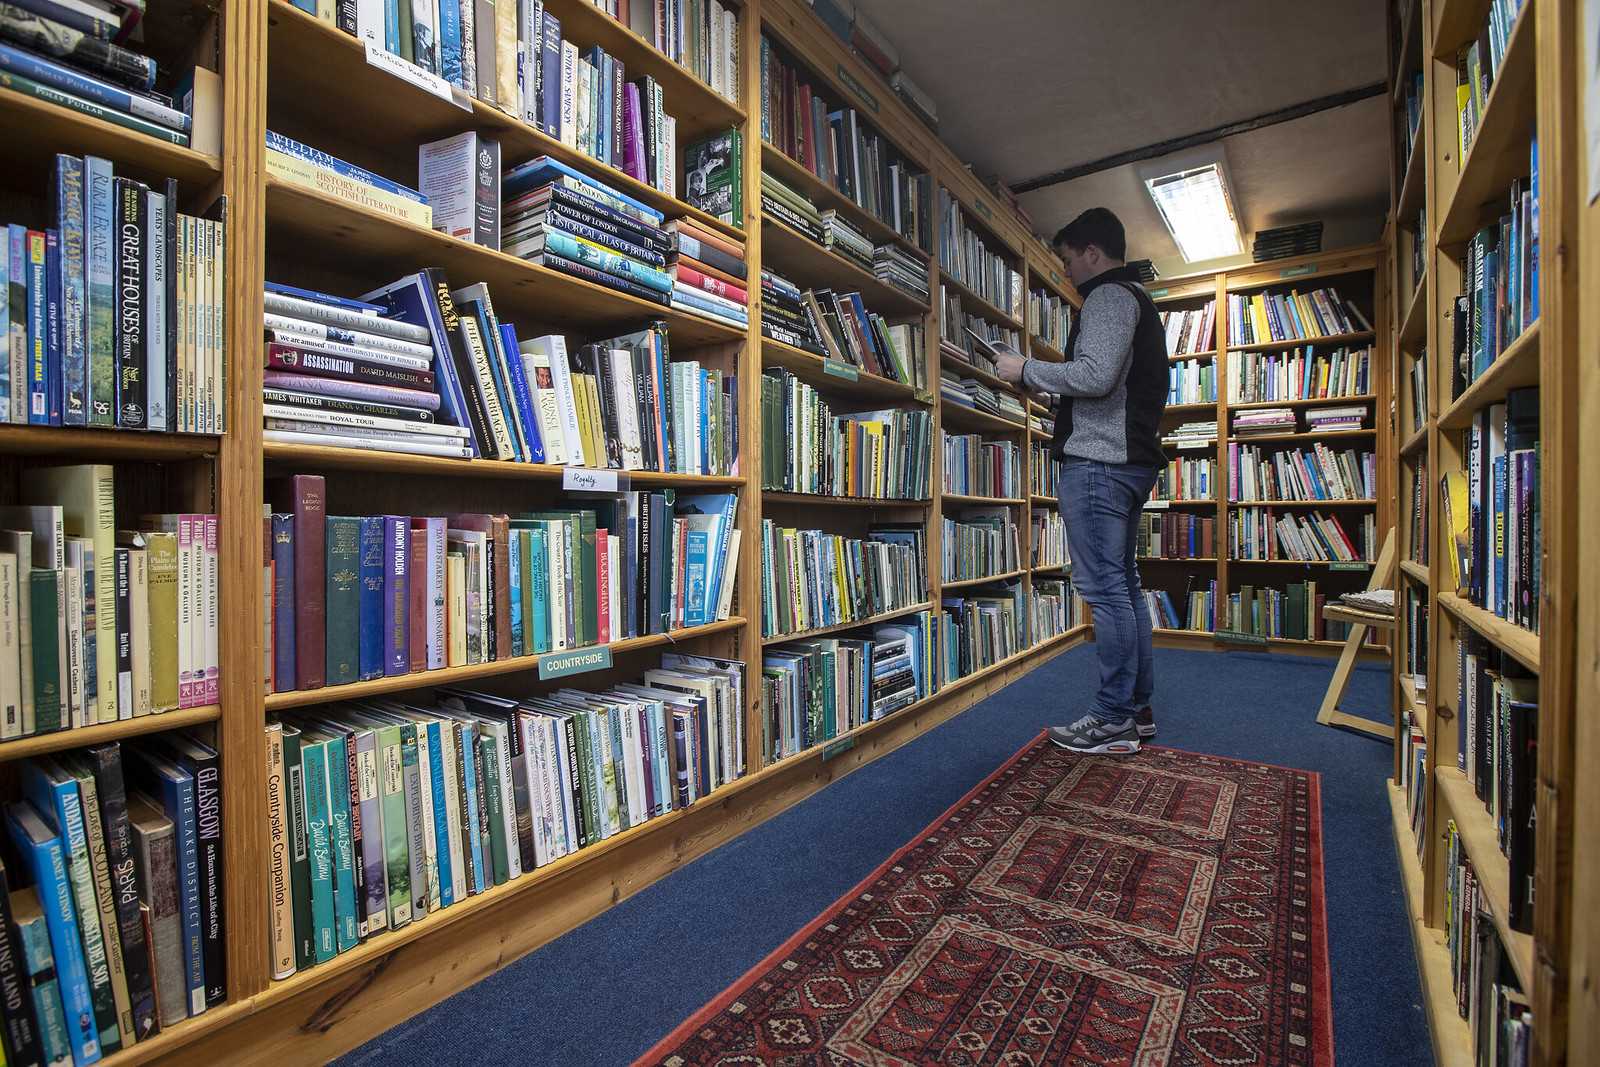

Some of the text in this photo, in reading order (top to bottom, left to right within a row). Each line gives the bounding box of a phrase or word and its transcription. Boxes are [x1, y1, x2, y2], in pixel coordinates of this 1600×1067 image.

[549, 213, 655, 262] HISTORICAL ATLAS OF BRITAIN
[555, 203, 618, 234] TOWER OF LONDON
[122, 224, 140, 335] GREAT HOUSES
[280, 334, 289, 343] We
[300, 338, 326, 348] amused
[303, 353, 354, 374] ASSASSINATION
[265, 392, 323, 406] JAMES WHITAKER
[467, 321, 505, 444] THE ROYAL MARRIAGES
[330, 415, 375, 425] ROYAL TOUR
[395, 520, 405, 575] ANTHONY HOLDEN
[600, 552, 609, 615] BUCKINGHAM
[547, 653, 603, 671] COUNTRYSIDE
[567, 722, 575, 747] DEVON
[571, 752, 580, 791] CORNWALL
[197, 766, 220, 840] GLASGOW
[348, 735, 362, 842] THE COASTS OF BRITAIN
[268, 775, 287, 907] Countryside Companion
[310, 819, 330, 880] David Bellamy
[334, 810, 352, 871] David Bellamy
[409, 773, 425, 874] EXPLORING BRITAIN
[184, 787, 200, 928] THE LAKE DISTRICT
